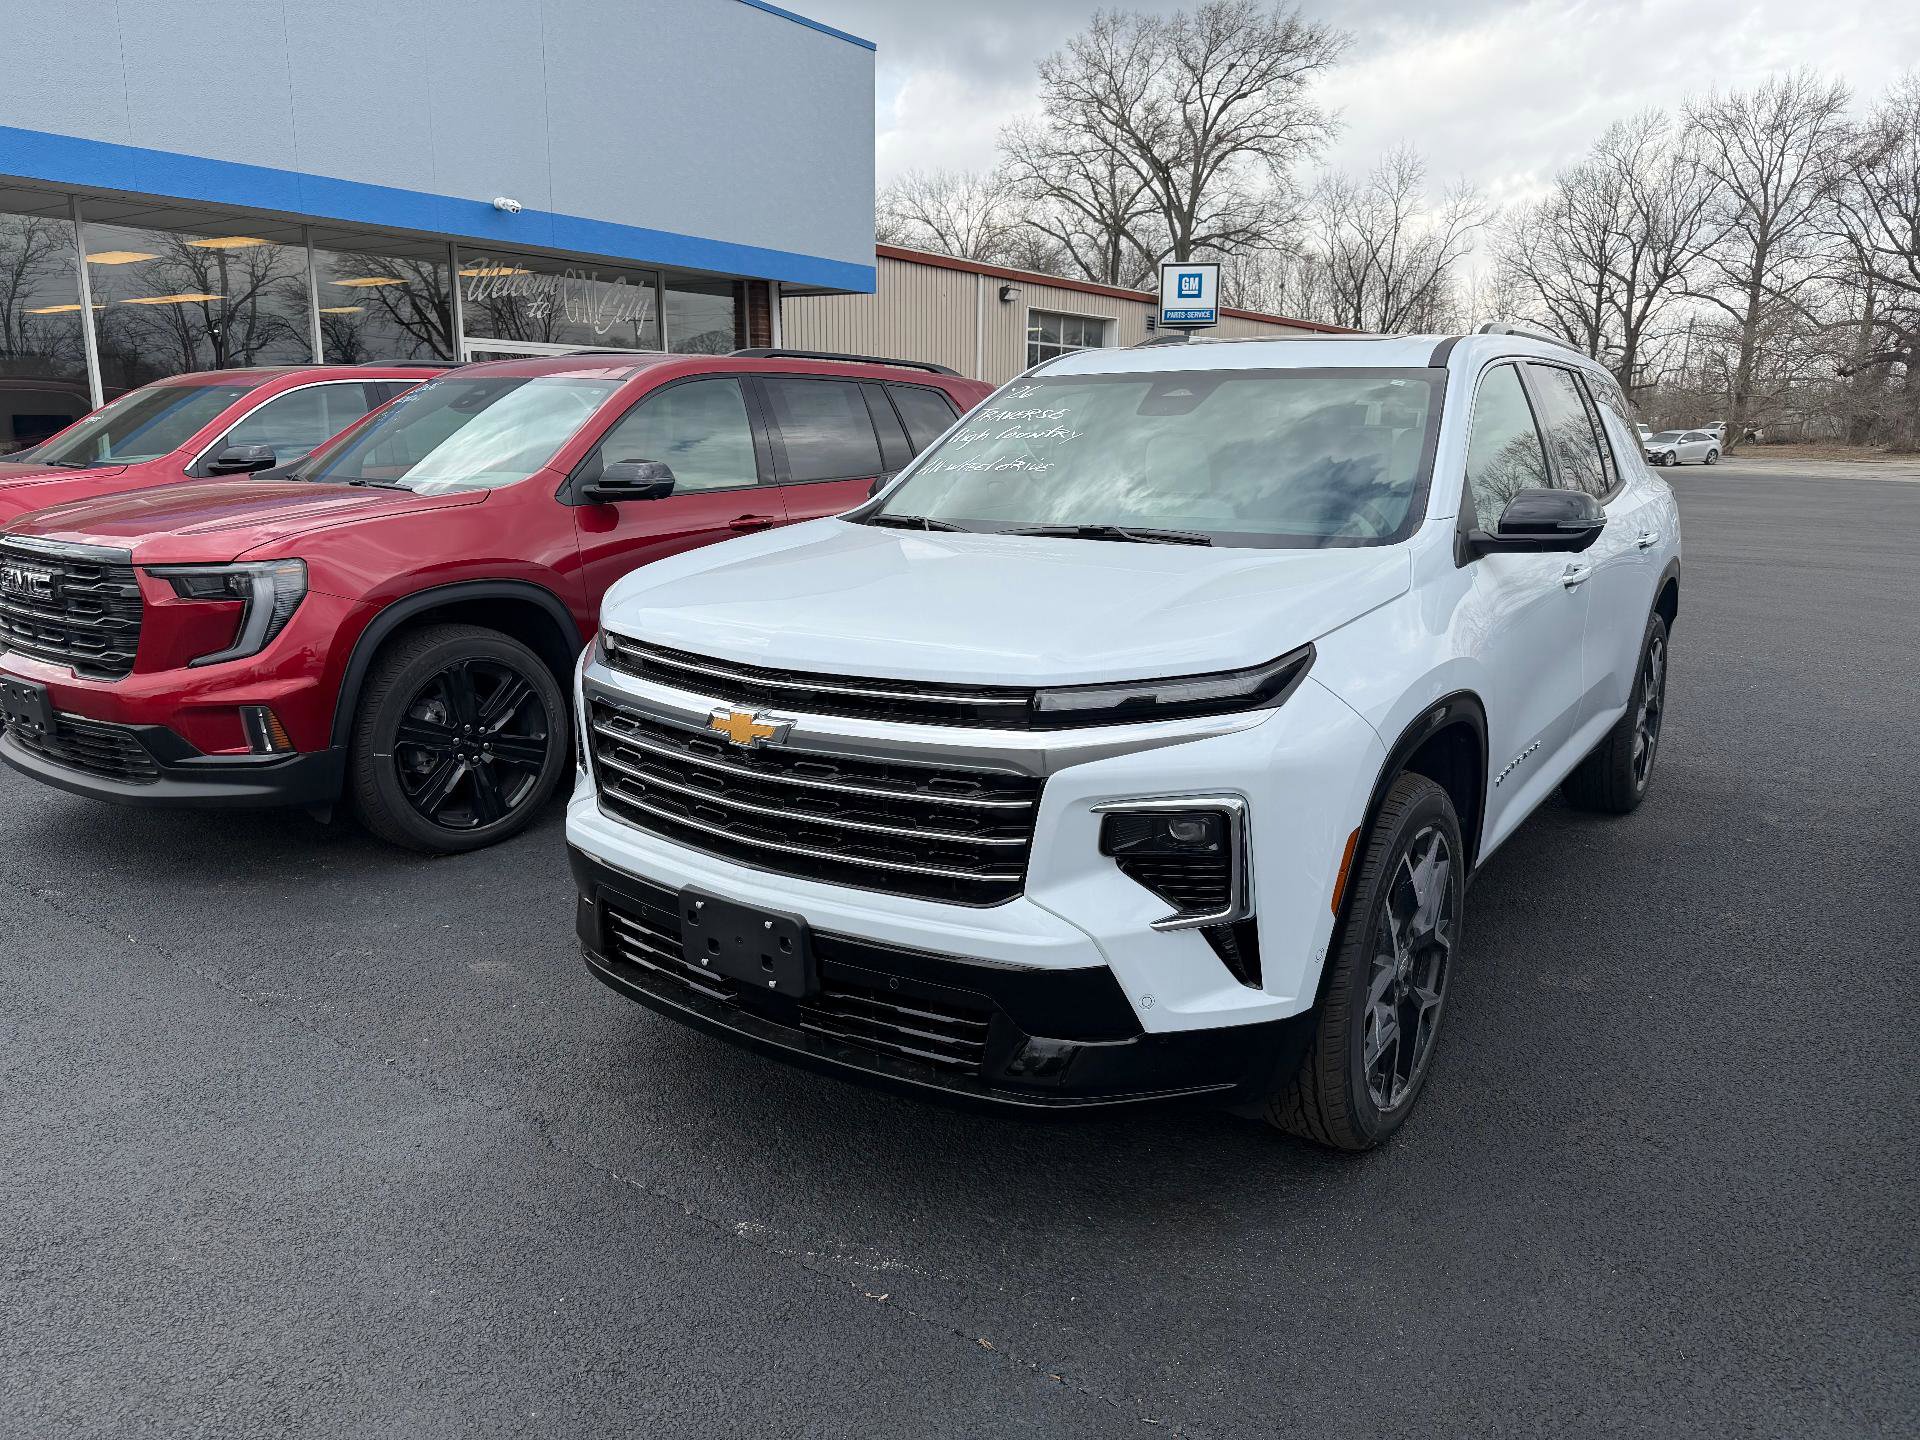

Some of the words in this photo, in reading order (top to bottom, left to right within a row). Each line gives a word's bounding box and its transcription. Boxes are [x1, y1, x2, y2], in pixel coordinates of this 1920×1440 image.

[465, 257, 562, 301] Welcome
[1181, 276, 1200, 291] GM
[526, 294, 551, 319] to
[594, 275, 650, 335] City
[947, 427, 990, 451] High
